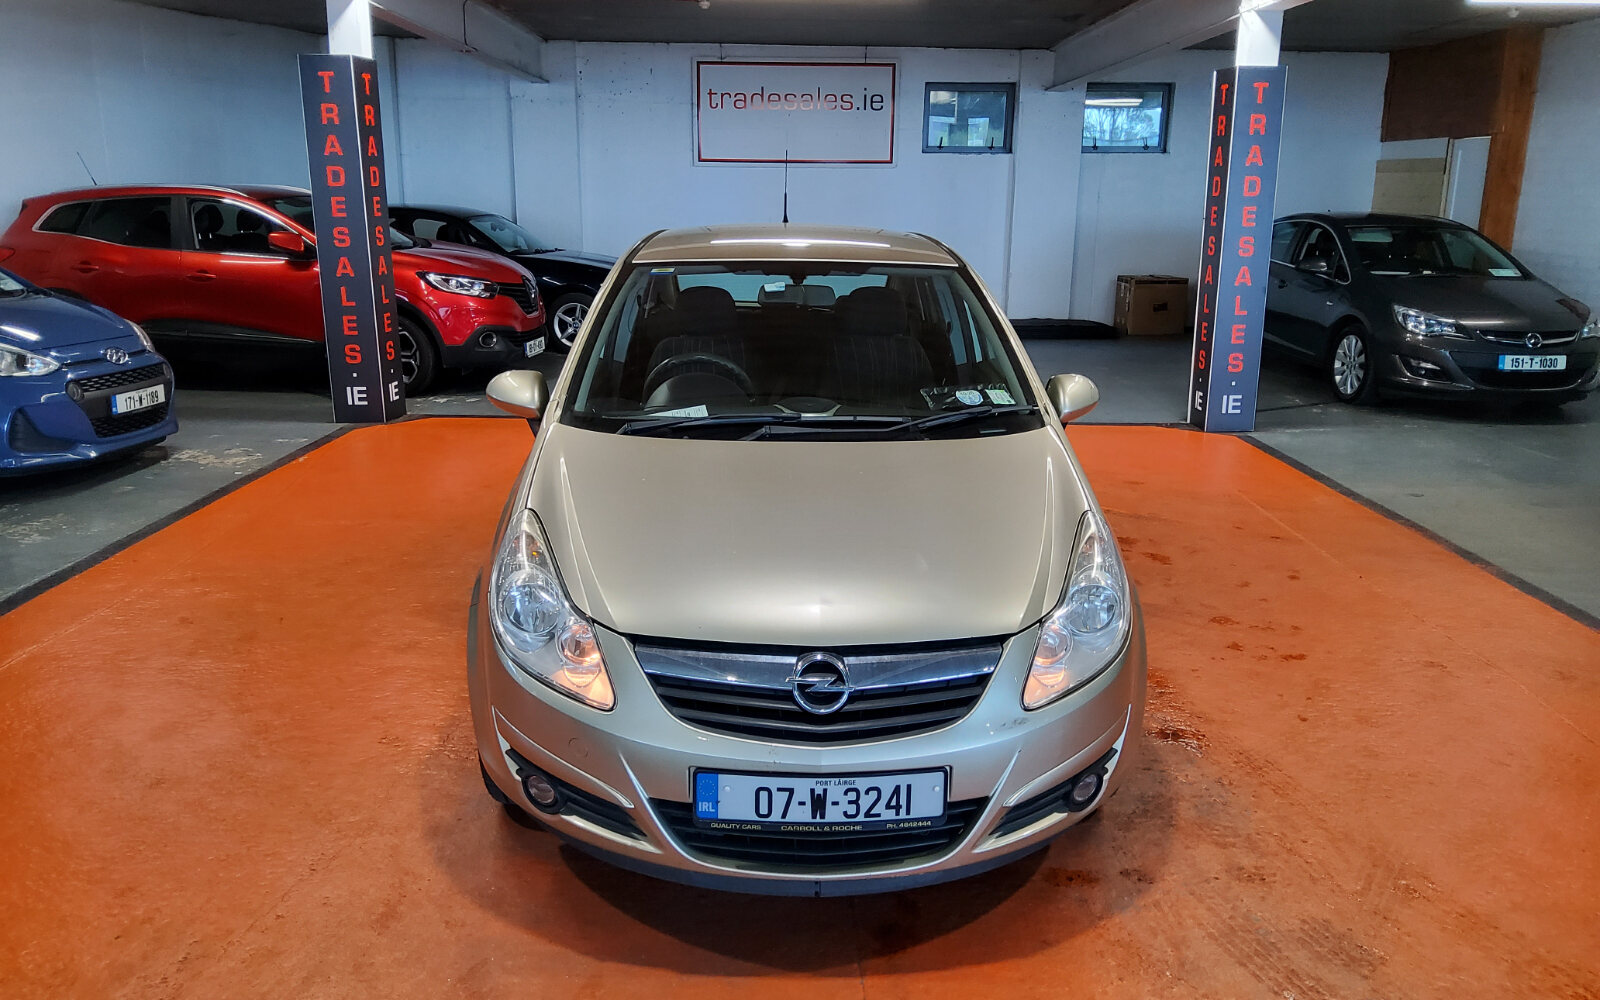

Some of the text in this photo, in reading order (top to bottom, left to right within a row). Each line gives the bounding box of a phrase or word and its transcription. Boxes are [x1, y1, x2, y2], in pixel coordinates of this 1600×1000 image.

[707, 86, 884, 111] tradesales.ie
[1510, 357, 1558, 368] 151-T-1030
[125, 390, 159, 410] 171-W-1189
[698, 801, 716, 813] IRL
[754, 783, 912, 820] 07-W-3241
